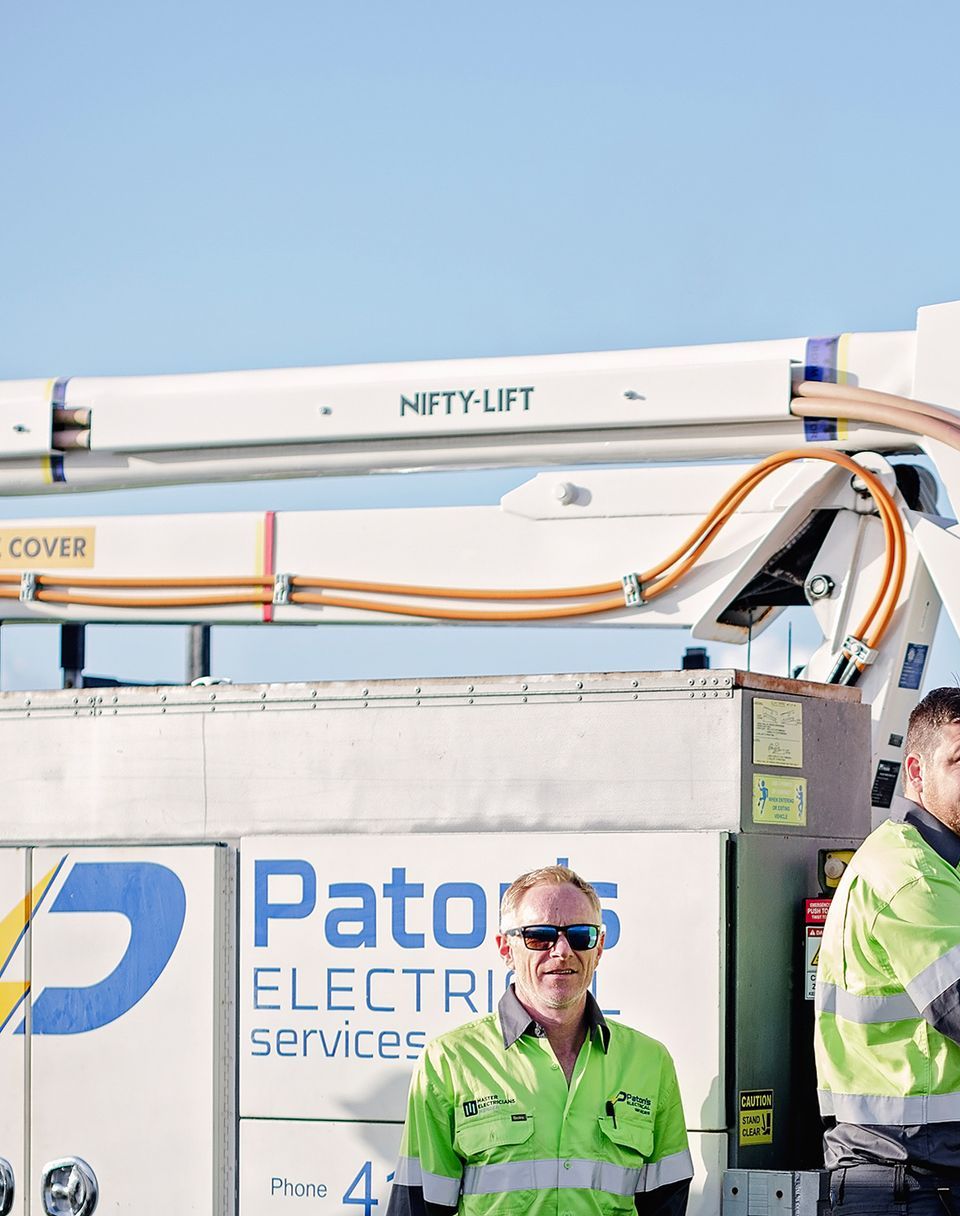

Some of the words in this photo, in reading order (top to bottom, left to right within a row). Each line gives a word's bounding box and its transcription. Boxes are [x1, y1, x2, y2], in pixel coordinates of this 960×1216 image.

[400, 386, 535, 416] NIFTY-LIFT
[9, 537, 87, 558] COVER
[253, 967, 621, 1015] ELECTRIL
[251, 1020, 426, 1060] services
[478, 1099, 516, 1109] ELECTRICIANS
[741, 1094, 772, 1107] CAUTION
[742, 1115, 760, 1125] STAND
[742, 1127, 761, 1136] CLEAR
[271, 1177, 328, 1198] Phone
